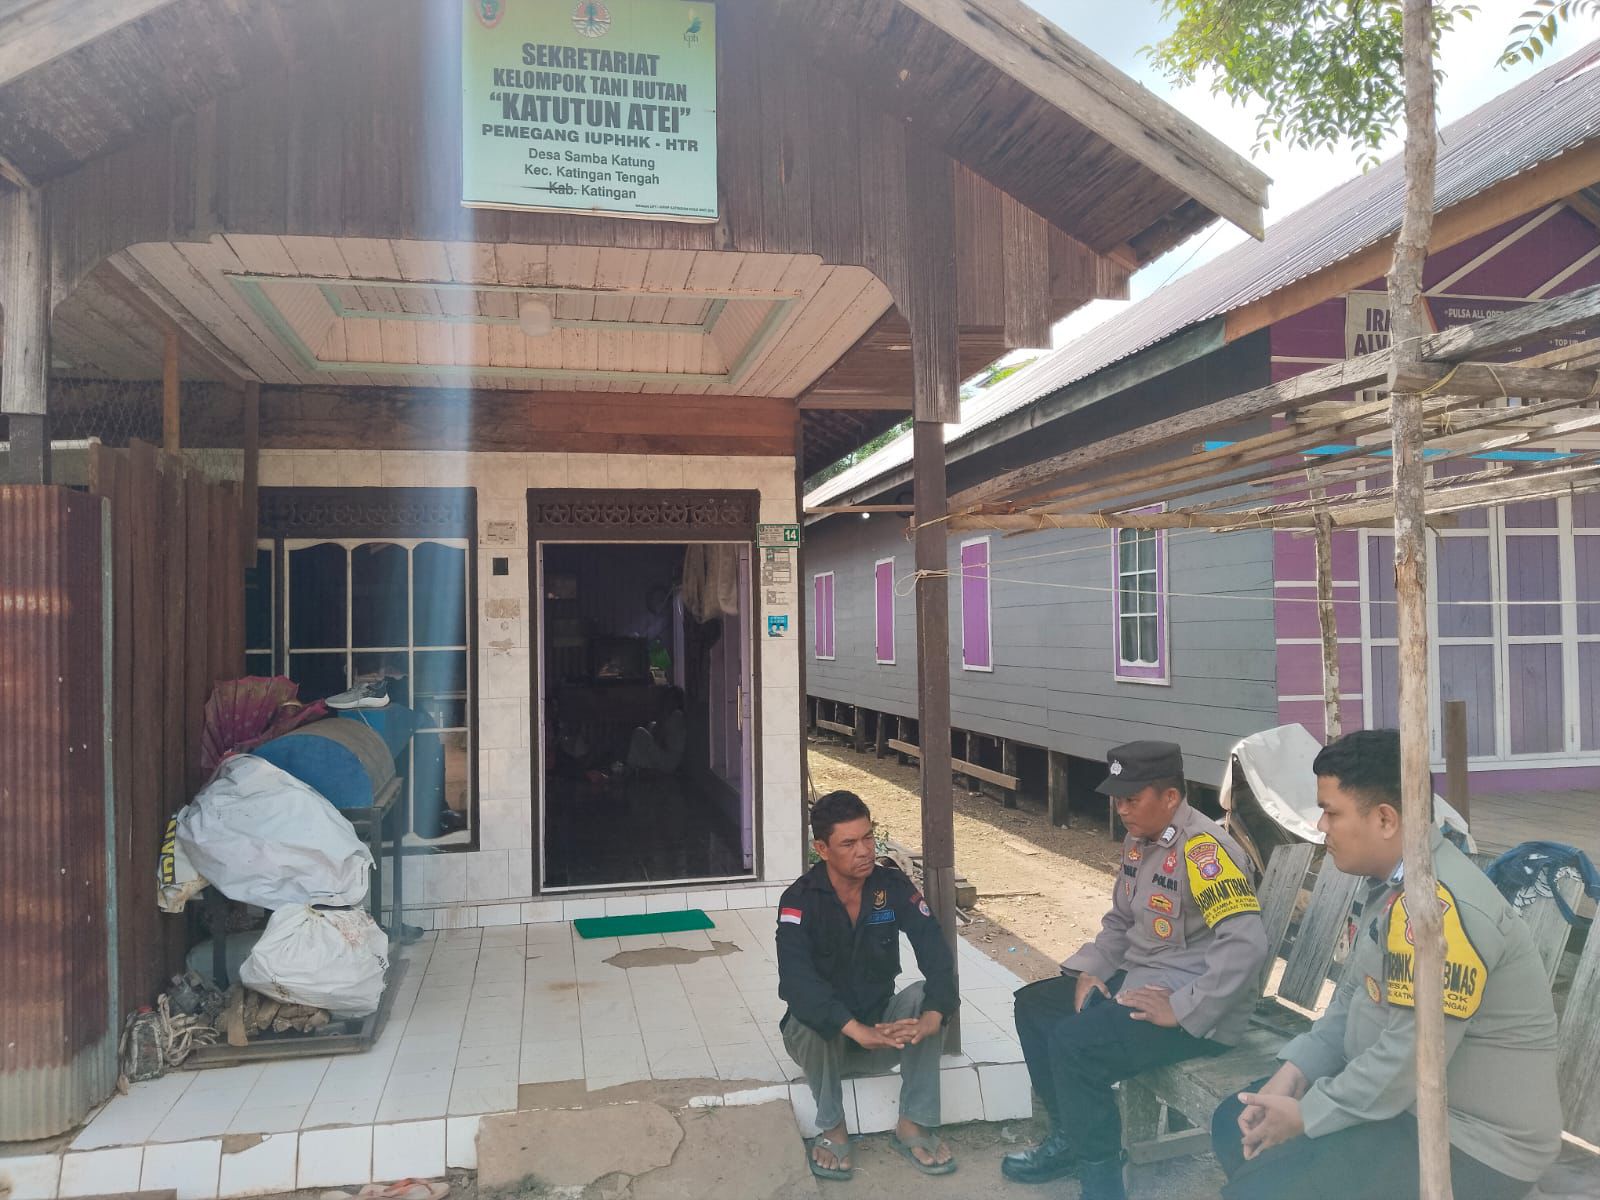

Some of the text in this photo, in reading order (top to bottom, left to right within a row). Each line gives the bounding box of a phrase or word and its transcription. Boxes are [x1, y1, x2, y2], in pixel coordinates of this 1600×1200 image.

[522, 42, 660, 76] SEKRETARIAT
[493, 68, 687, 102] KELOMPOK TANI HUTAN
[482, 124, 580, 143] PEMEGANG
[585, 131, 651, 149] IUPHHK
[665, 139, 699, 152] HTR
[528, 148, 655, 170] Desa Samba Katung
[524, 164, 660, 187] Kec. Katingan Tengah
[549, 181, 636, 200] Kab. Katingan
[1448, 308, 1470, 319] PULSA
[1472, 309, 1485, 319] ALL
[1354, 334, 1391, 356] ALV
[1555, 339, 1568, 347] TOP
[785, 530, 797, 540] 14
[1152, 873, 1177, 891] POLRI
[1389, 982, 1409, 991] ESA
